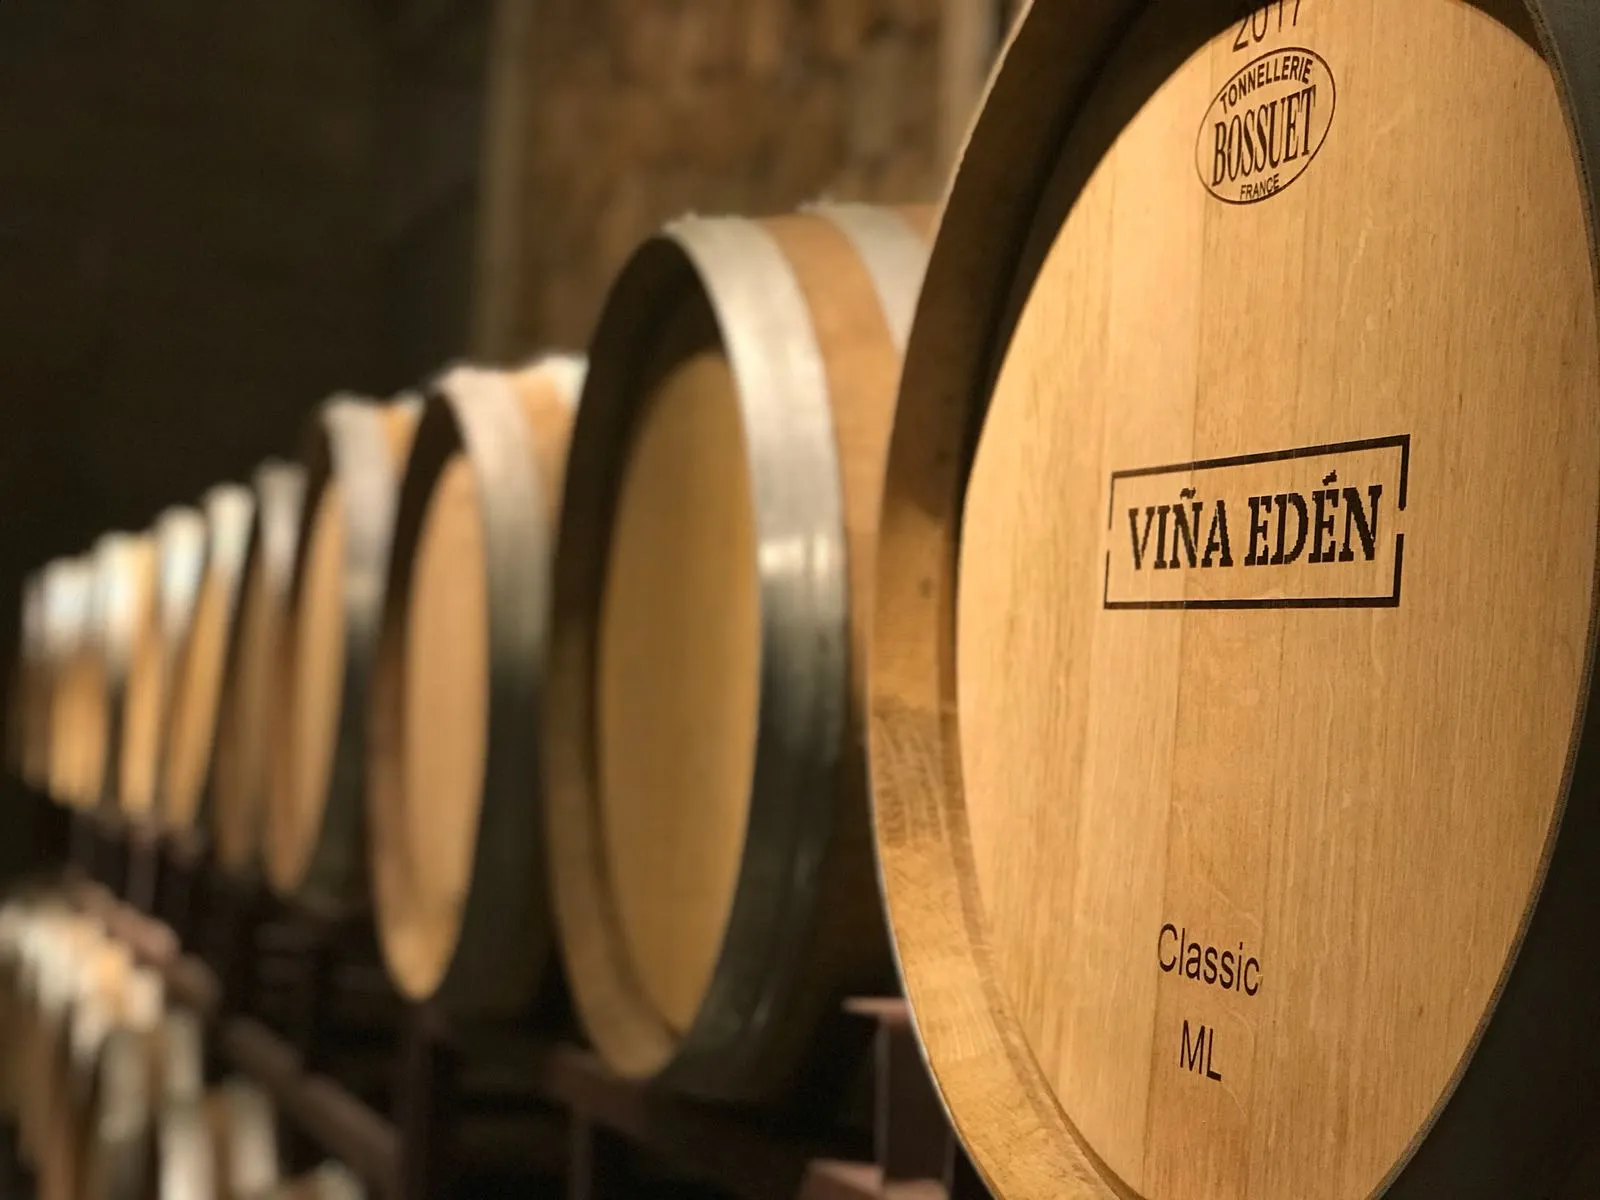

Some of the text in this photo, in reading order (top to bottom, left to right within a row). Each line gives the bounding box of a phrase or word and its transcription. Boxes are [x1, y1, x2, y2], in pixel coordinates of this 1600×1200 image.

[1220, 55, 1313, 114] TONNELLERIE
[1212, 84, 1316, 187] BOSSUET
[1239, 173, 1280, 200] FRANCE
[1128, 469, 1383, 570] VIÑA EDÉN
[1157, 923, 1261, 996] Classic
[1180, 1019, 1222, 1082] ML
